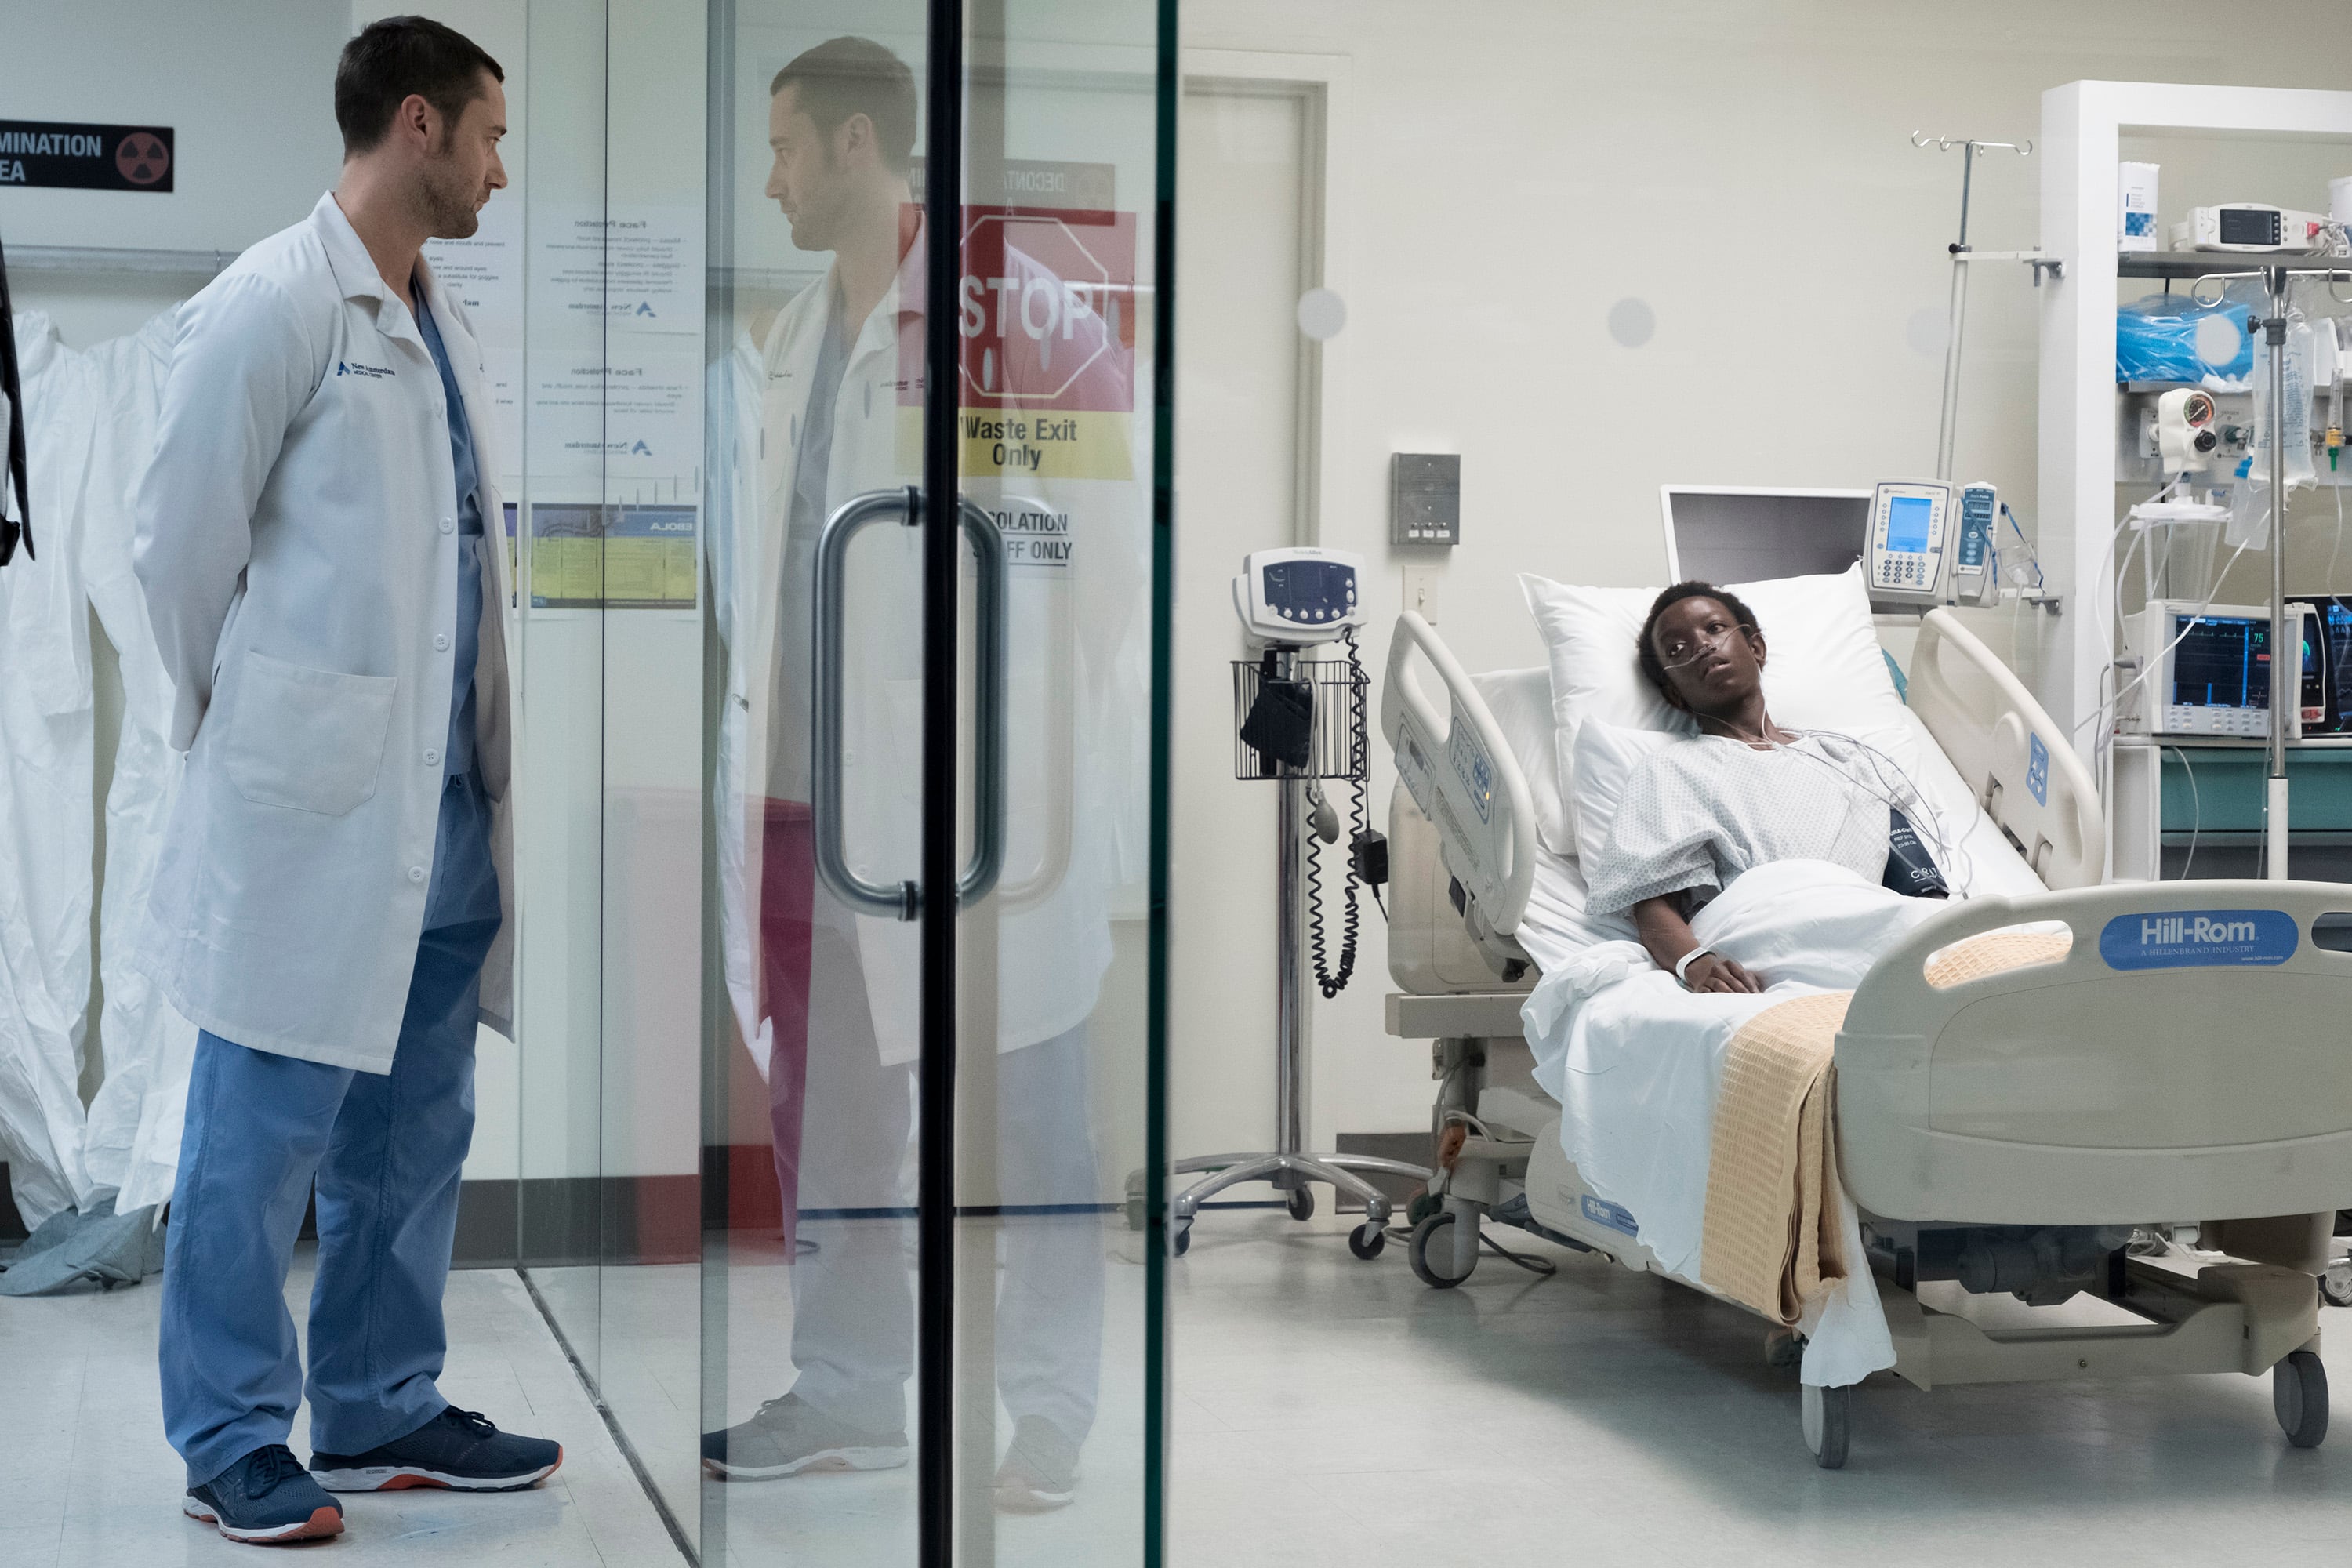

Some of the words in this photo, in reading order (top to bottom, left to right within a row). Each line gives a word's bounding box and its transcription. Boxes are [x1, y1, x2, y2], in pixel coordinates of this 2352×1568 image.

[959, 275, 1094, 339] STOP
[964, 416, 1027, 441] Waste
[1036, 419, 1077, 441] Exit
[993, 443, 1041, 471] Only
[988, 511, 1068, 532] OLATION
[1031, 541, 1073, 560] ONLY
[2254, 633, 2264, 643] 75
[2141, 916, 2256, 945] Hill-Rom
[2149, 946, 2209, 956] HILLENBRAND
[2212, 945, 2255, 954] INDUSTRY
